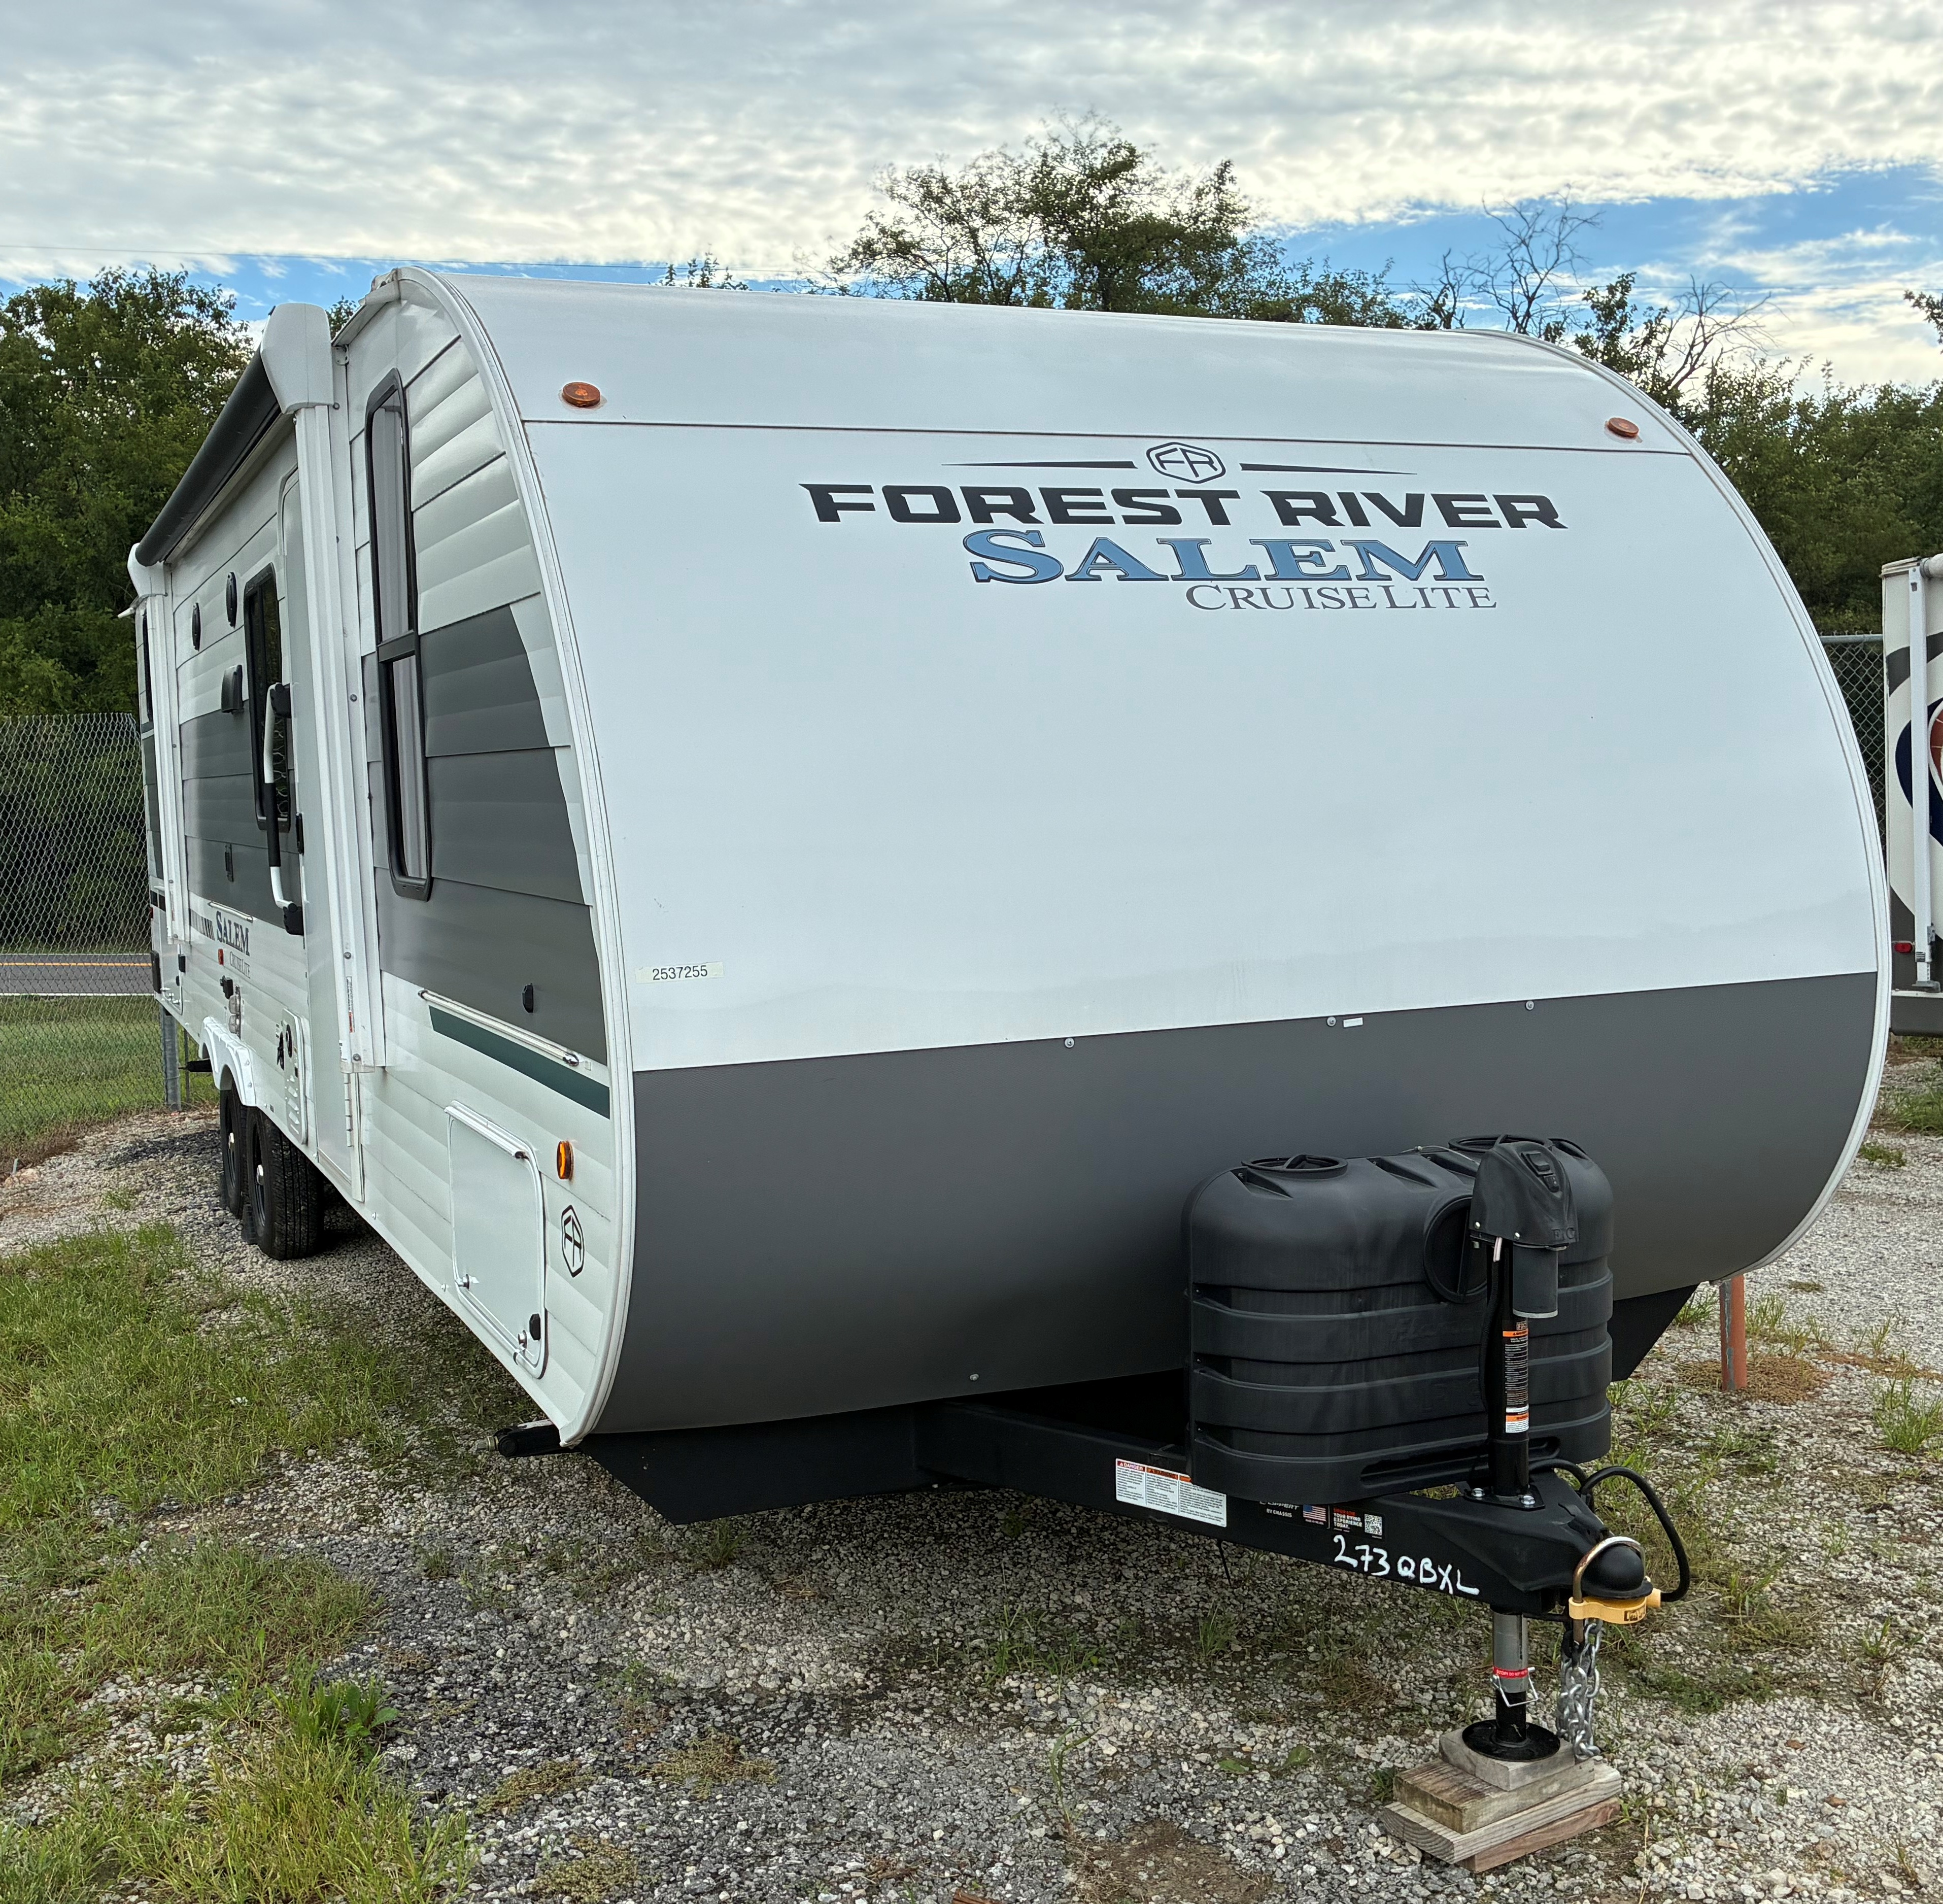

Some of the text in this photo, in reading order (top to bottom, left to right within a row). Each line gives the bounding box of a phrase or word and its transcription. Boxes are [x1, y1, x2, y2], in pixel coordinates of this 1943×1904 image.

[798, 483, 1569, 529] FOREST RIVER
[963, 529, 1485, 584] SALEM
[216, 910, 250, 957] SALEM
[652, 965, 708, 980] 2537255
[1123, 1462, 1144, 1471] DANGER
